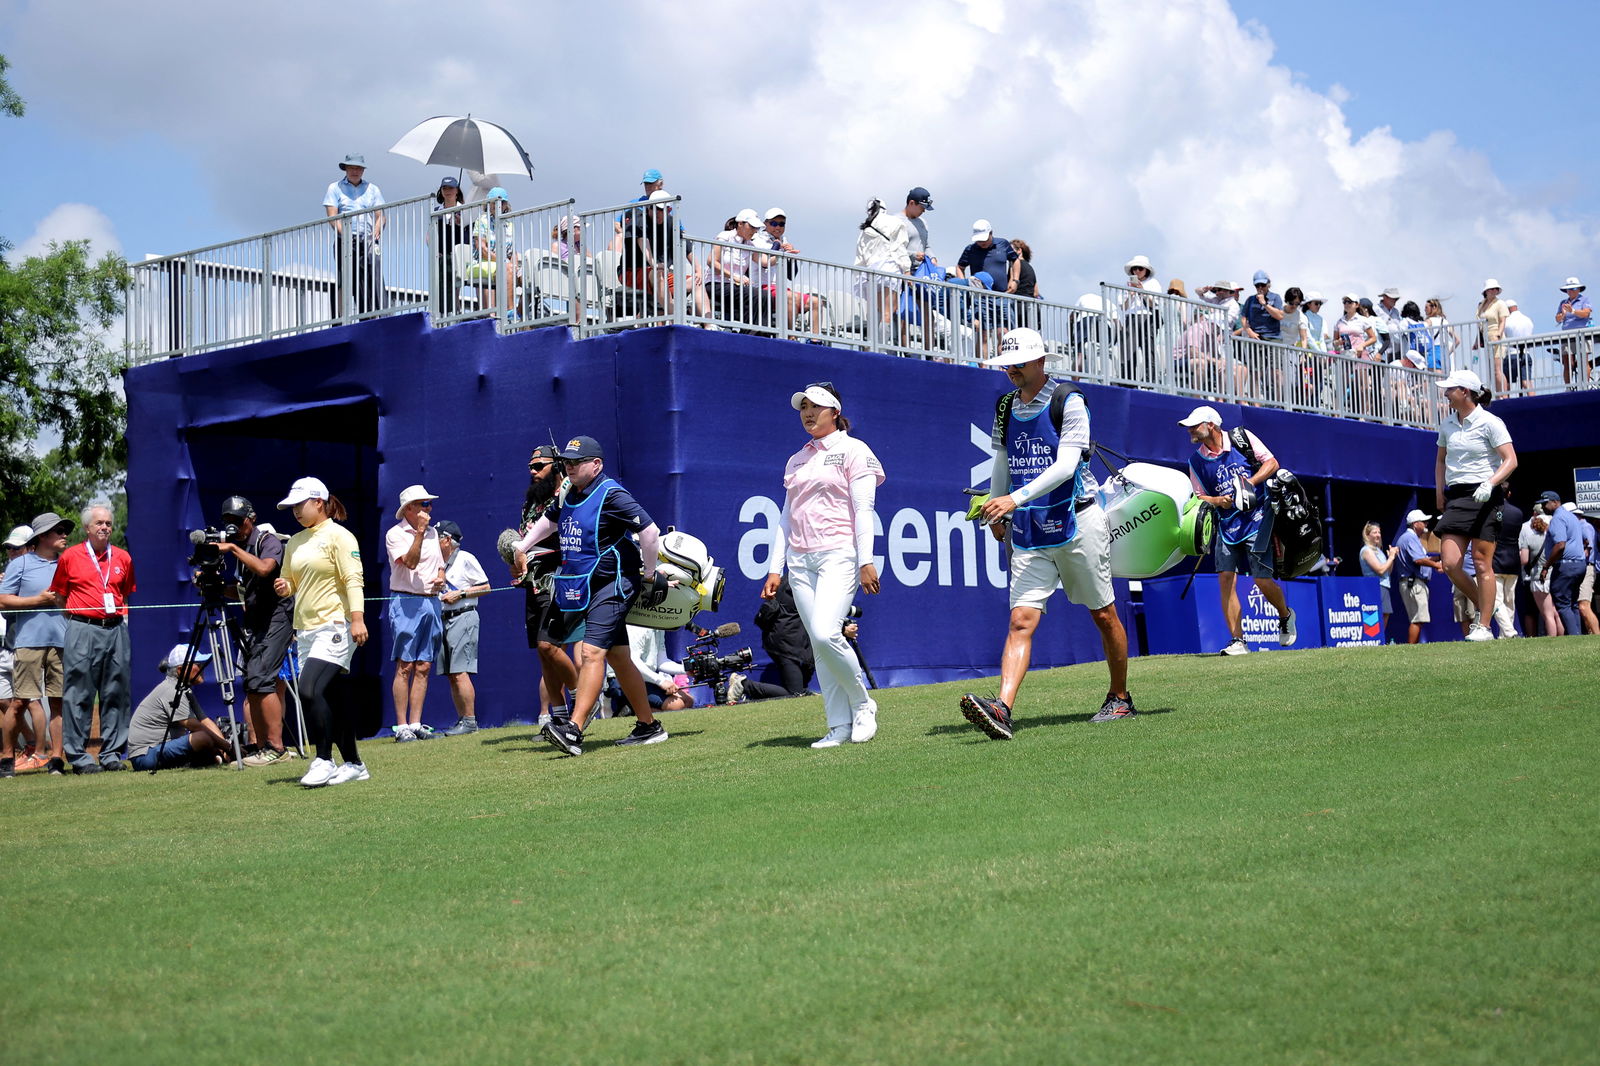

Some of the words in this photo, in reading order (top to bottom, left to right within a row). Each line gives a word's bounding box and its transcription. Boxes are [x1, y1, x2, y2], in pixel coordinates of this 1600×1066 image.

[1031, 442, 1051, 455] the
[1007, 455, 1053, 467] chevron
[1343, 592, 1360, 608] the
[1328, 608, 1362, 624] human
[1242, 632, 1279, 644] championshi
[1330, 625, 1363, 641] energy
